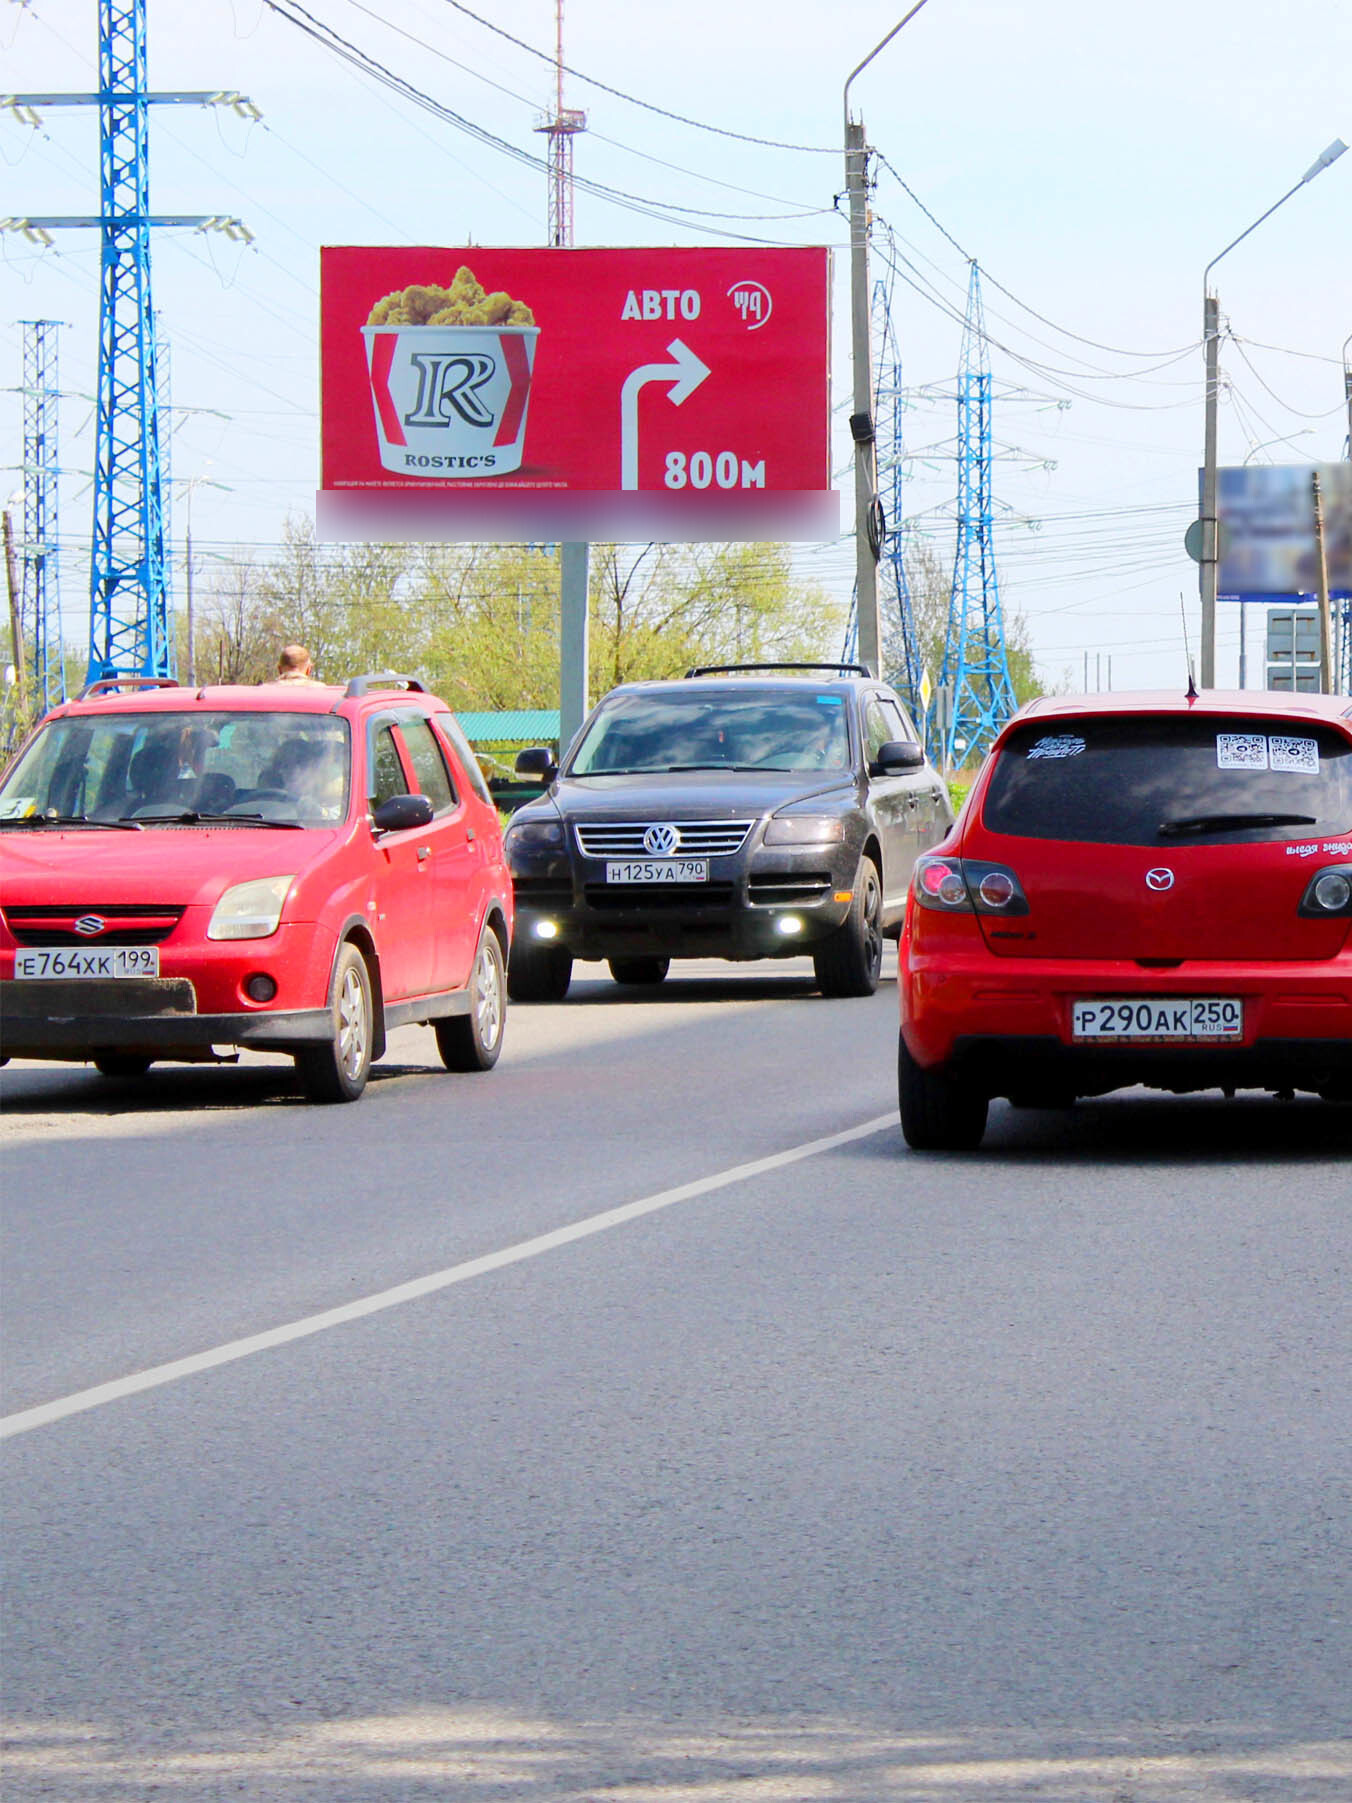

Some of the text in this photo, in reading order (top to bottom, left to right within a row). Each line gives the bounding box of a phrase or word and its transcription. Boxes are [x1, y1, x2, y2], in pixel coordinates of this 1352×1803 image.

[621, 290, 701, 321] АВТО
[405, 353, 496, 428] R
[404, 454, 497, 469] ROSTIC'S
[612, 864, 675, 880] Н125УА
[678, 863, 703, 874] 790
[23, 951, 151, 976] Е764ХК 199
[1081, 1003, 1236, 1031] Р290АК 250
